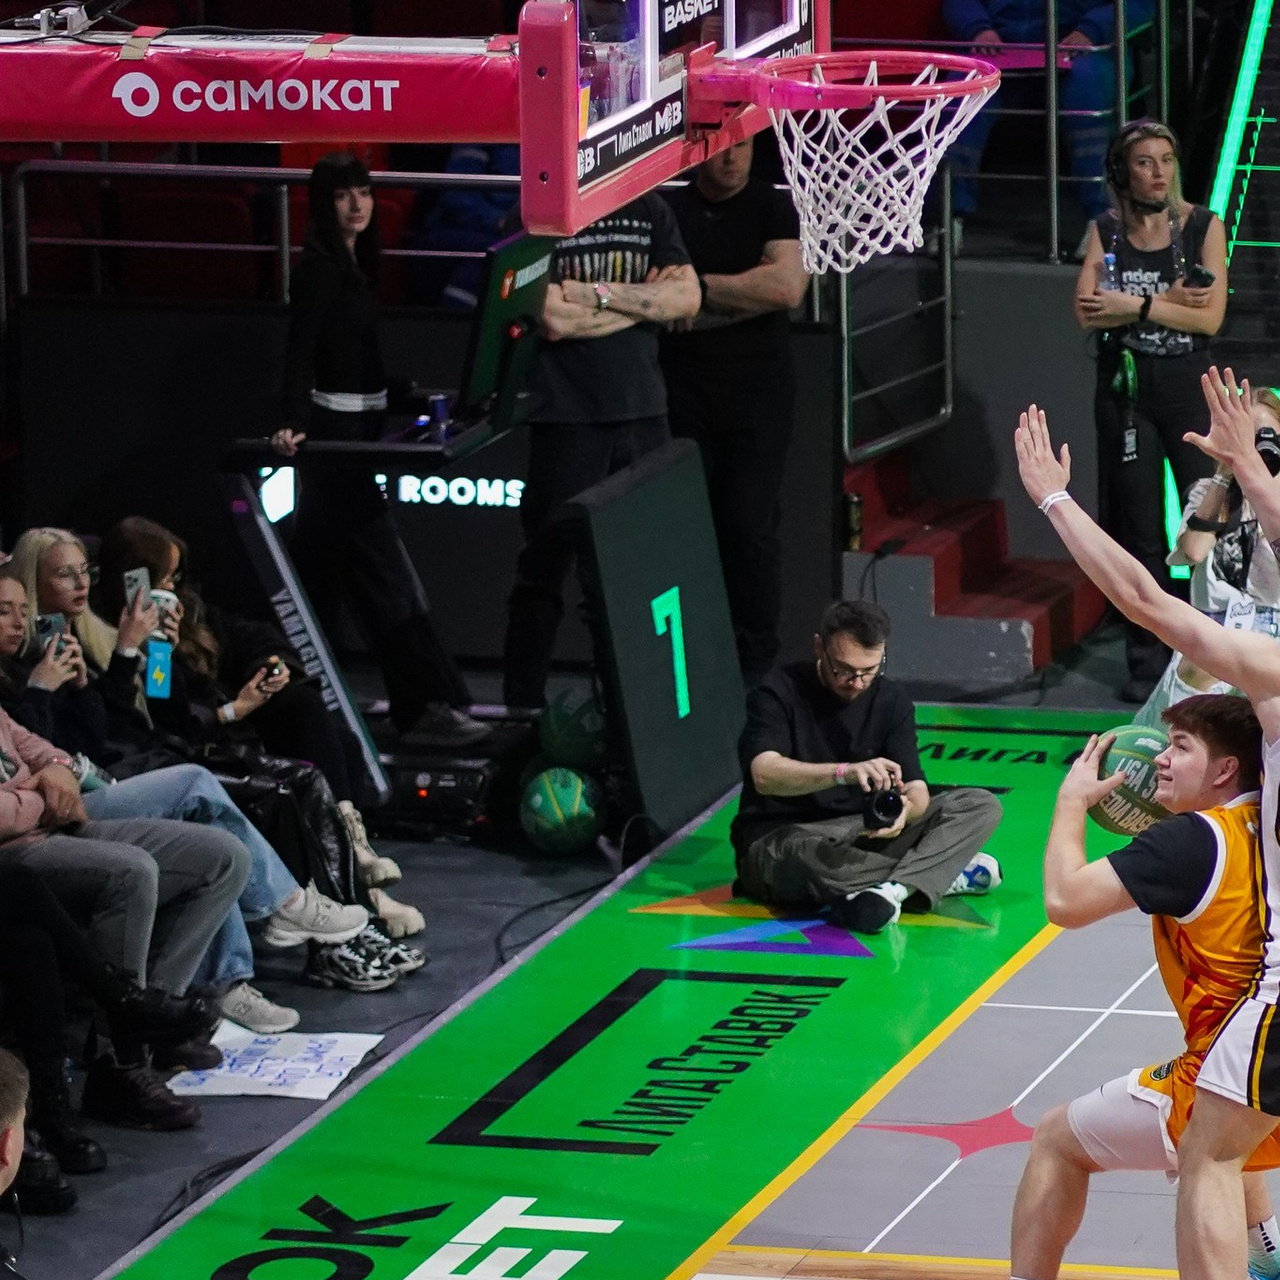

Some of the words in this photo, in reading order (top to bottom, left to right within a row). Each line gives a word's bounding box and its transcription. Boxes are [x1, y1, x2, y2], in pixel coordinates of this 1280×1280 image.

[172, 78, 399, 112] самокат
[398, 474, 527, 508] ROOMS
[1099, 788, 1132, 823] EDIA
